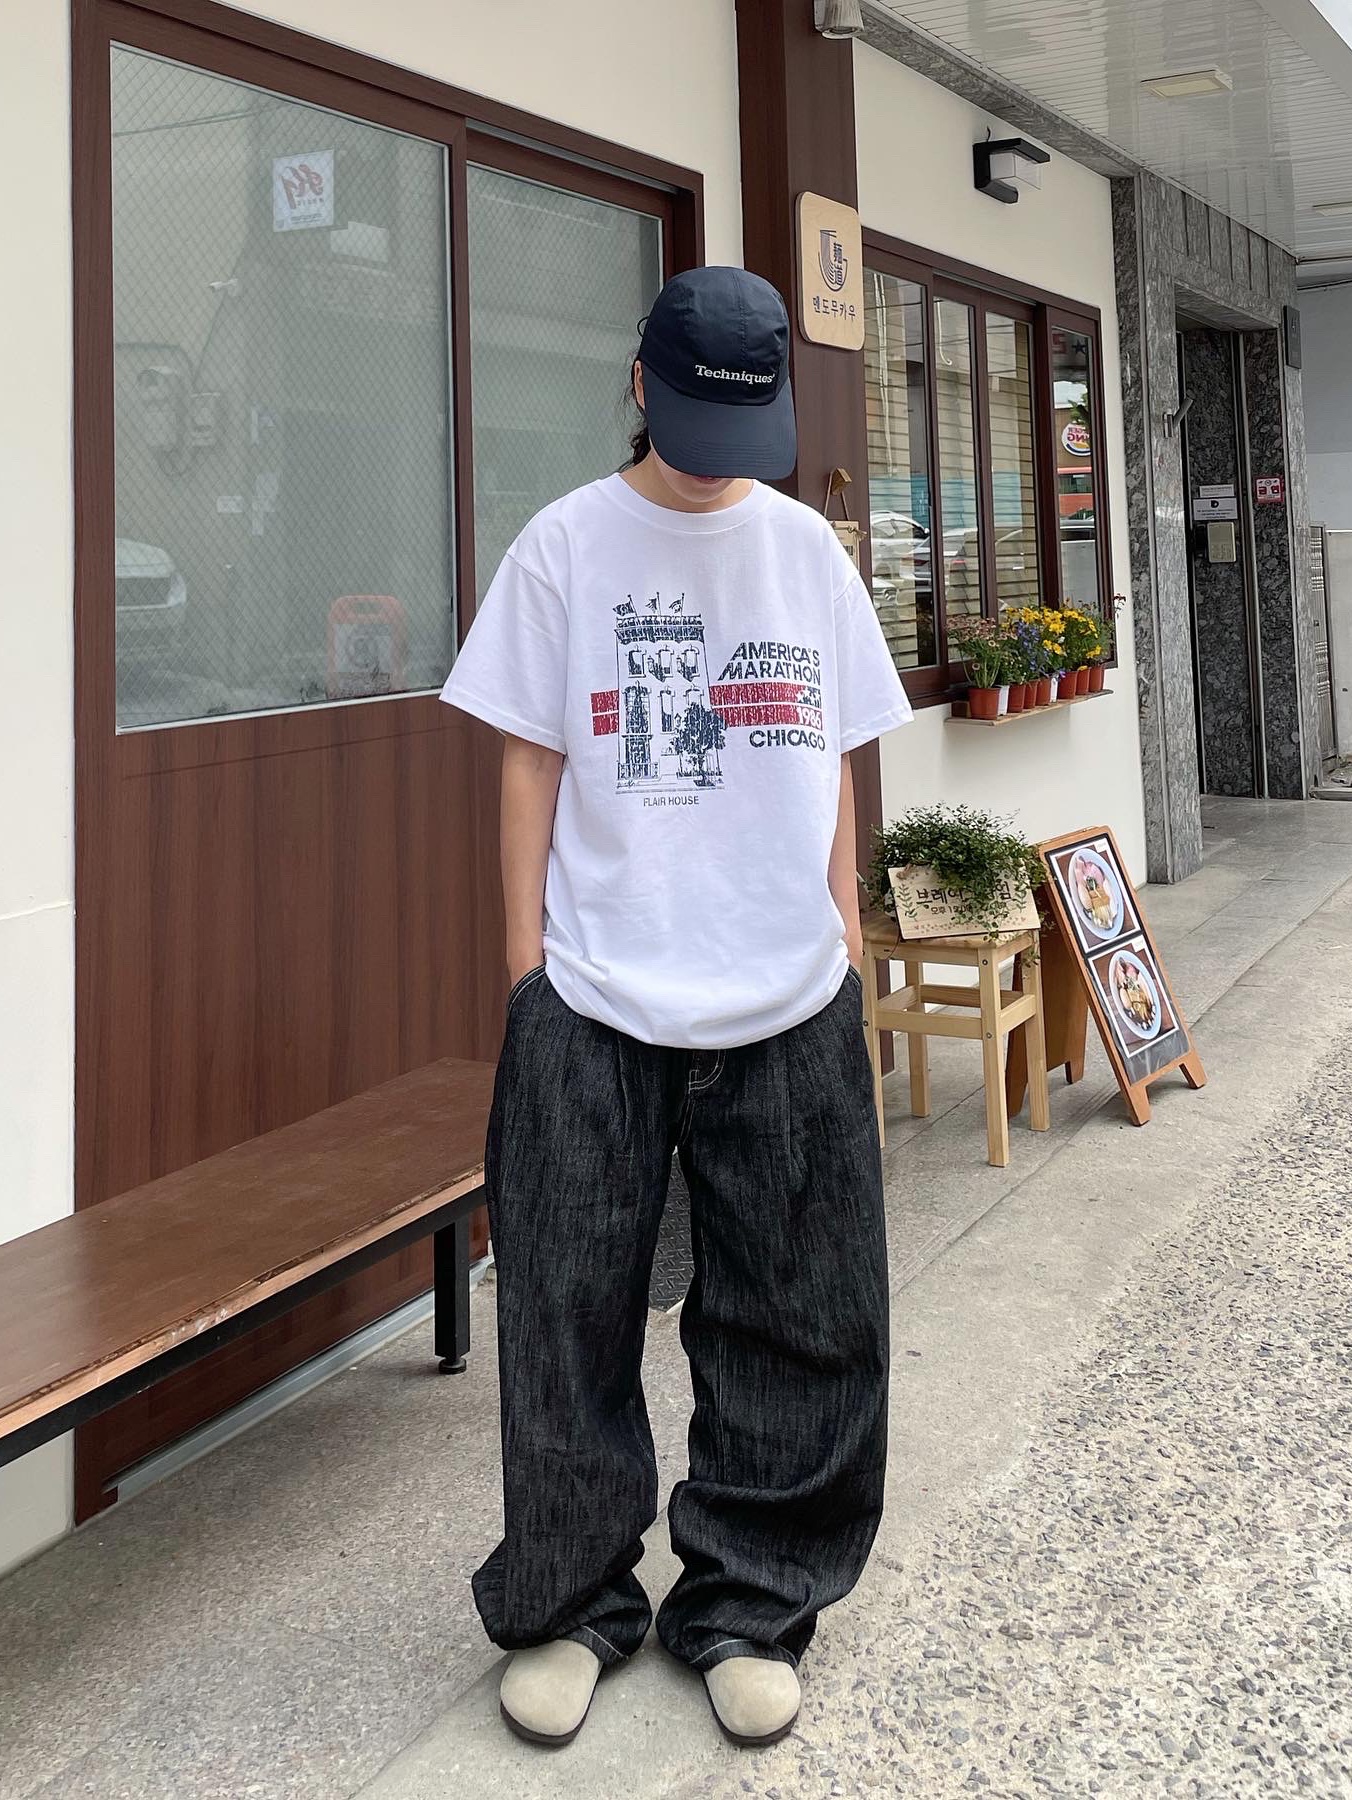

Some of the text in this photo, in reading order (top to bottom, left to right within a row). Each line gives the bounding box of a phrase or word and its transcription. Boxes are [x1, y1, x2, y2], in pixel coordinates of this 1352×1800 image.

[730, 641, 820, 667] AMERICA'S
[717, 660, 821, 686] MARATHON
[749, 729, 825, 752] CHICAGO
[643, 795, 700, 807] FLAIR HOUSE
